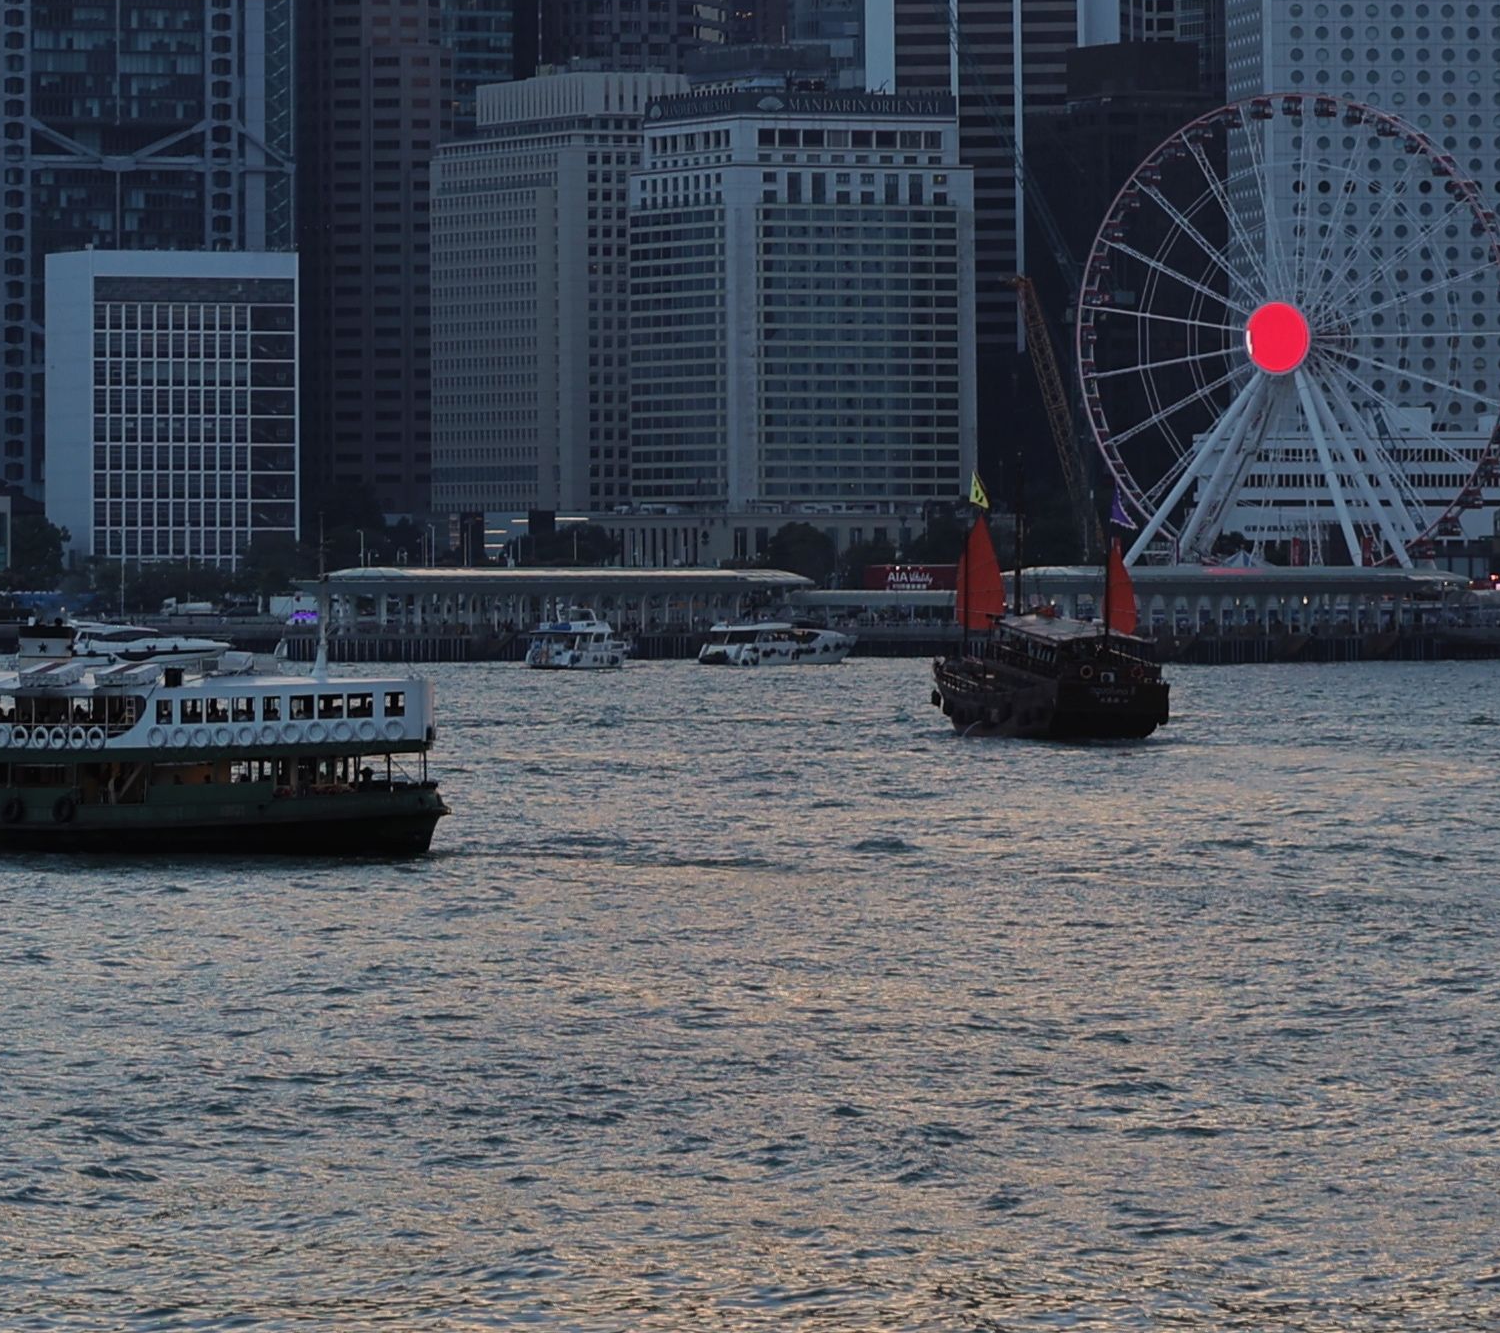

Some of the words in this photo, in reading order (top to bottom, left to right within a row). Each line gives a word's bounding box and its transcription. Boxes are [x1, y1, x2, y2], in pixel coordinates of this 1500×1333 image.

[788, 92, 867, 113] MANDARIN
[870, 97, 942, 115] ORIENTAL
[888, 572, 908, 582] AIA
